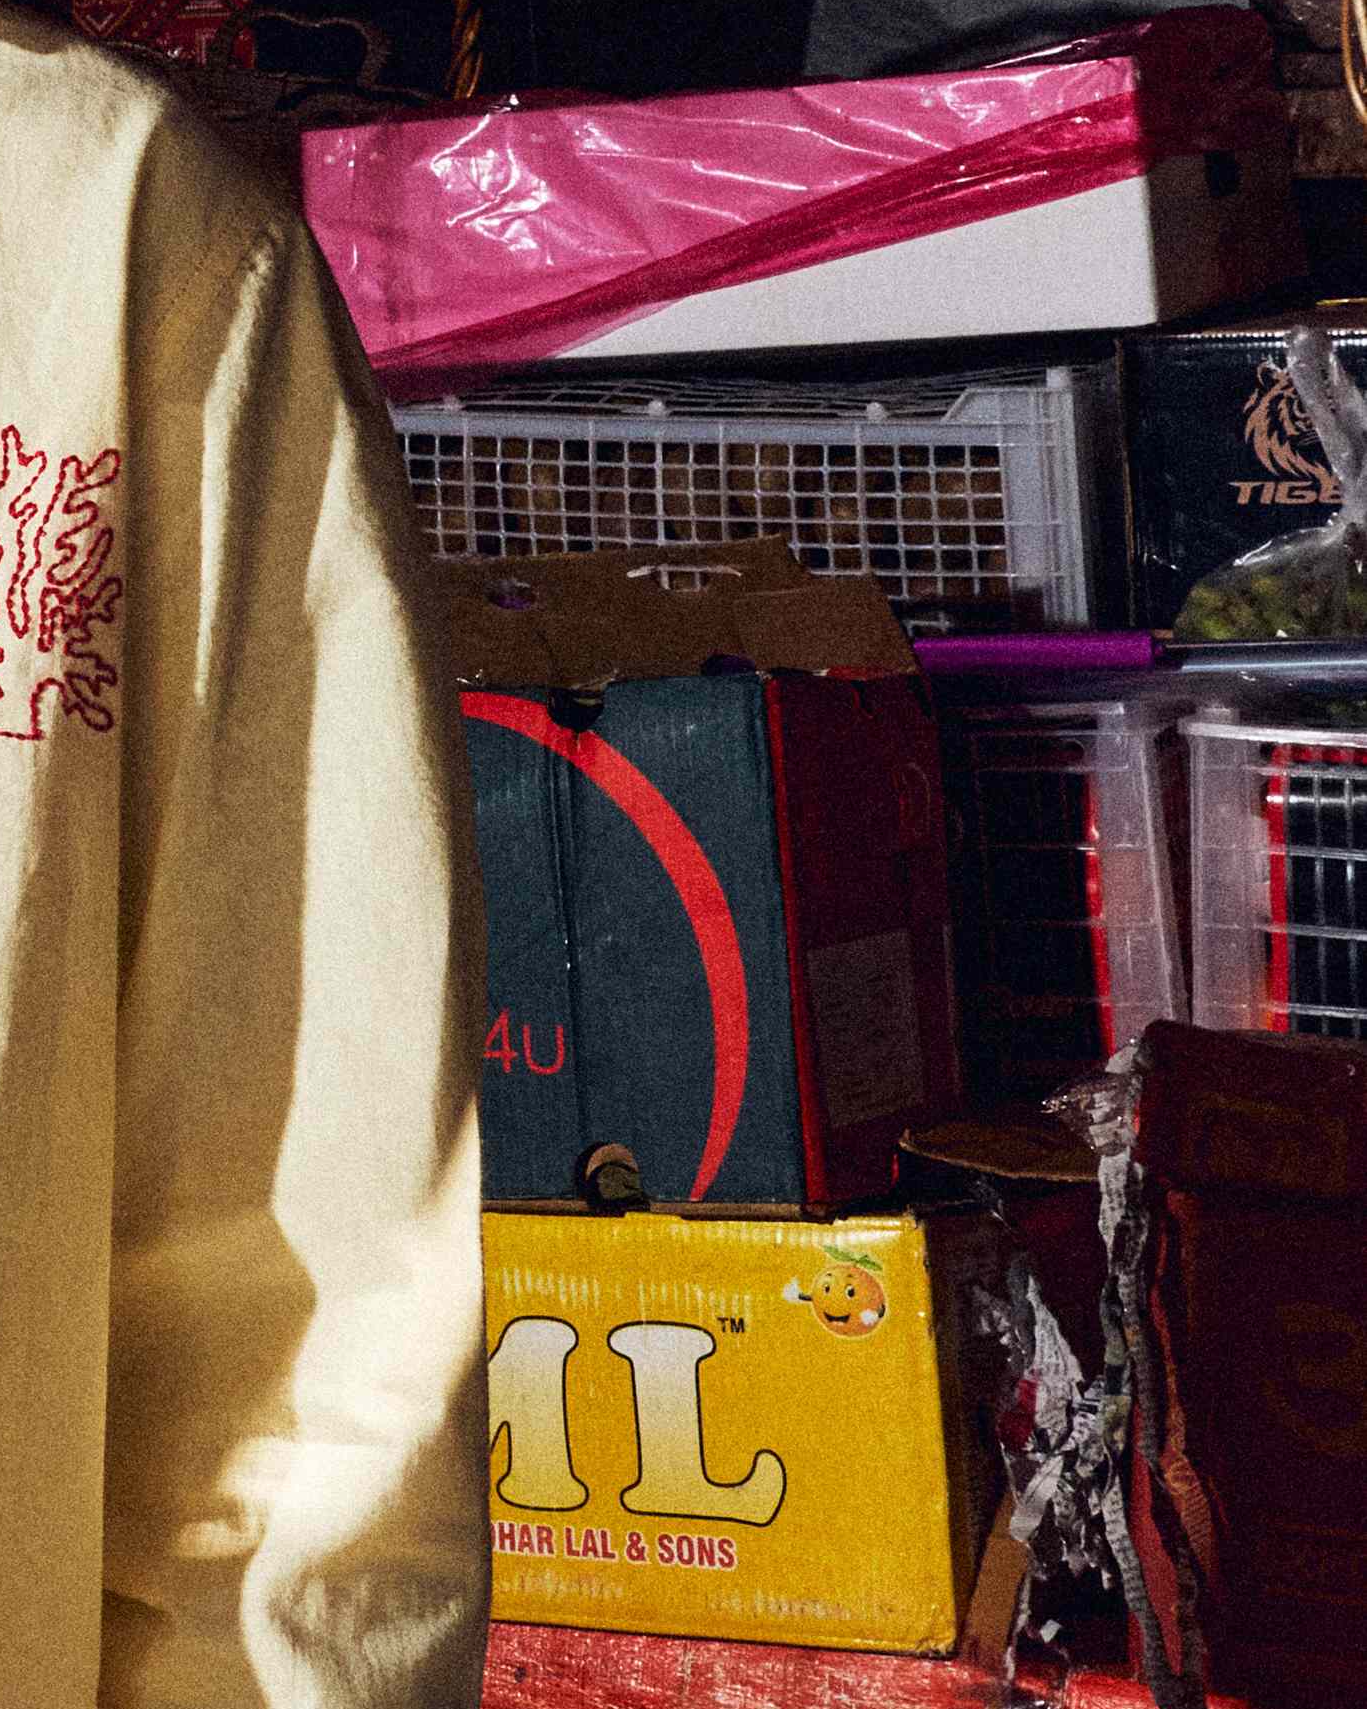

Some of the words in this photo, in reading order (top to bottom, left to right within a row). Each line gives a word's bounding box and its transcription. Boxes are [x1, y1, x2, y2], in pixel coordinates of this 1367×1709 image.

[565, 1527, 616, 1560] LAL
[626, 1531, 646, 1561] &
[658, 1534, 735, 1569] SONS
